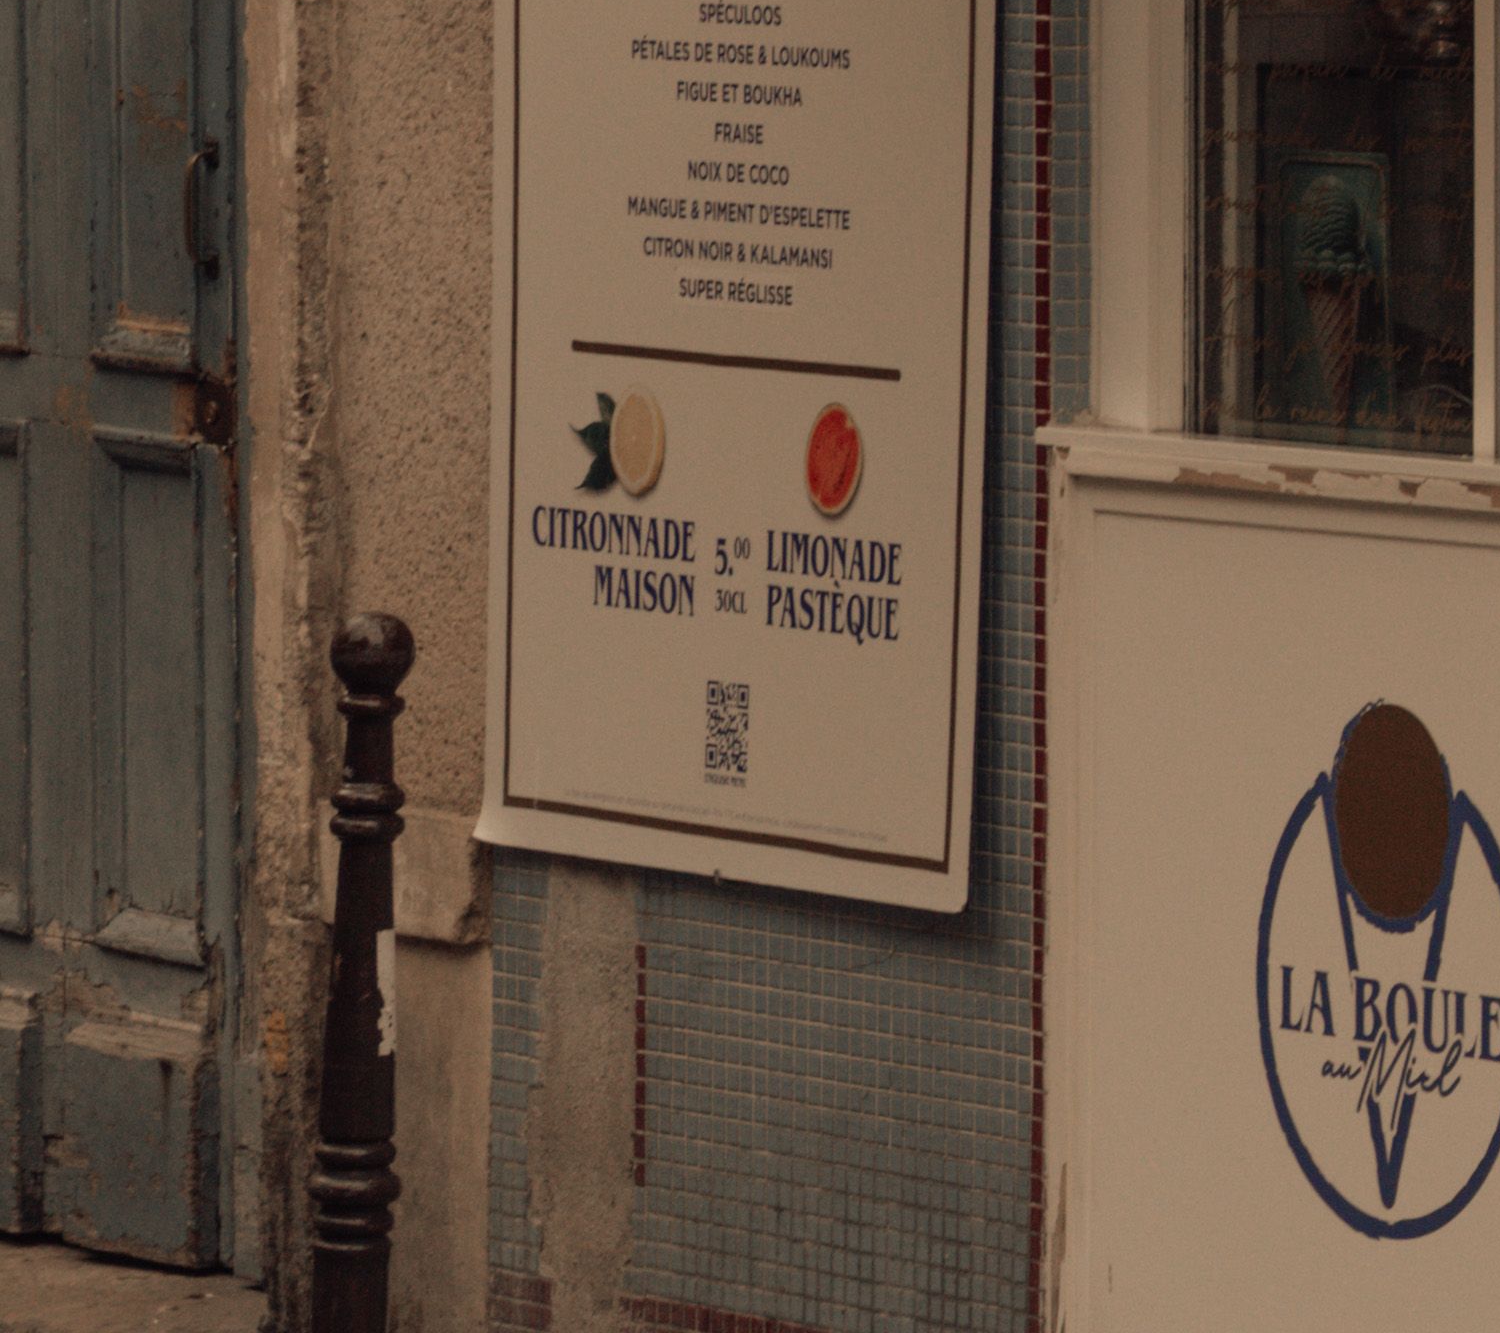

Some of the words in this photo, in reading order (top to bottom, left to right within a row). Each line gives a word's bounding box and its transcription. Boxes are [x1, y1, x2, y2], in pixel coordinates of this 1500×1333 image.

[698, 0, 783, 27] SPÉCULOOS
[631, 35, 691, 62] PÉTALES
[694, 41, 713, 64] DE
[716, 42, 755, 66] ROSE
[757, 44, 768, 66] &
[771, 45, 851, 70] LOUKOUMS
[676, 80, 718, 103] FIGUE
[721, 82, 740, 104] ET
[742, 83, 803, 107] BOUKHA
[714, 121, 764, 146] FRAISE
[687, 160, 722, 182] NOIX
[725, 162, 746, 184] DE
[748, 163, 790, 187] COCO
[627, 196, 687, 220] MANGUE
[689, 199, 701, 221] &
[703, 200, 756, 224] PIMENT
[758, 203, 851, 231] D'ESPELETTE
[642, 235, 695, 259] CITRON
[697, 240, 734, 262] NOIR
[736, 242, 747, 264] &
[749, 244, 833, 270] KALAMANSI
[679, 277, 724, 301] SUPER
[727, 278, 793, 307] RÉGLISSE
[531, 505, 697, 564] CITRONNADE
[714, 536, 751, 578] 5.00
[765, 529, 903, 588] LIMONADE
[593, 564, 696, 618] MAISON
[714, 588, 748, 616] 30CL
[765, 577, 900, 646] PASTÈQUE
[1279, 965, 1336, 1037] LA
[1321, 1056, 1363, 1080] au
[1356, 1027, 1462, 1130] Miel
